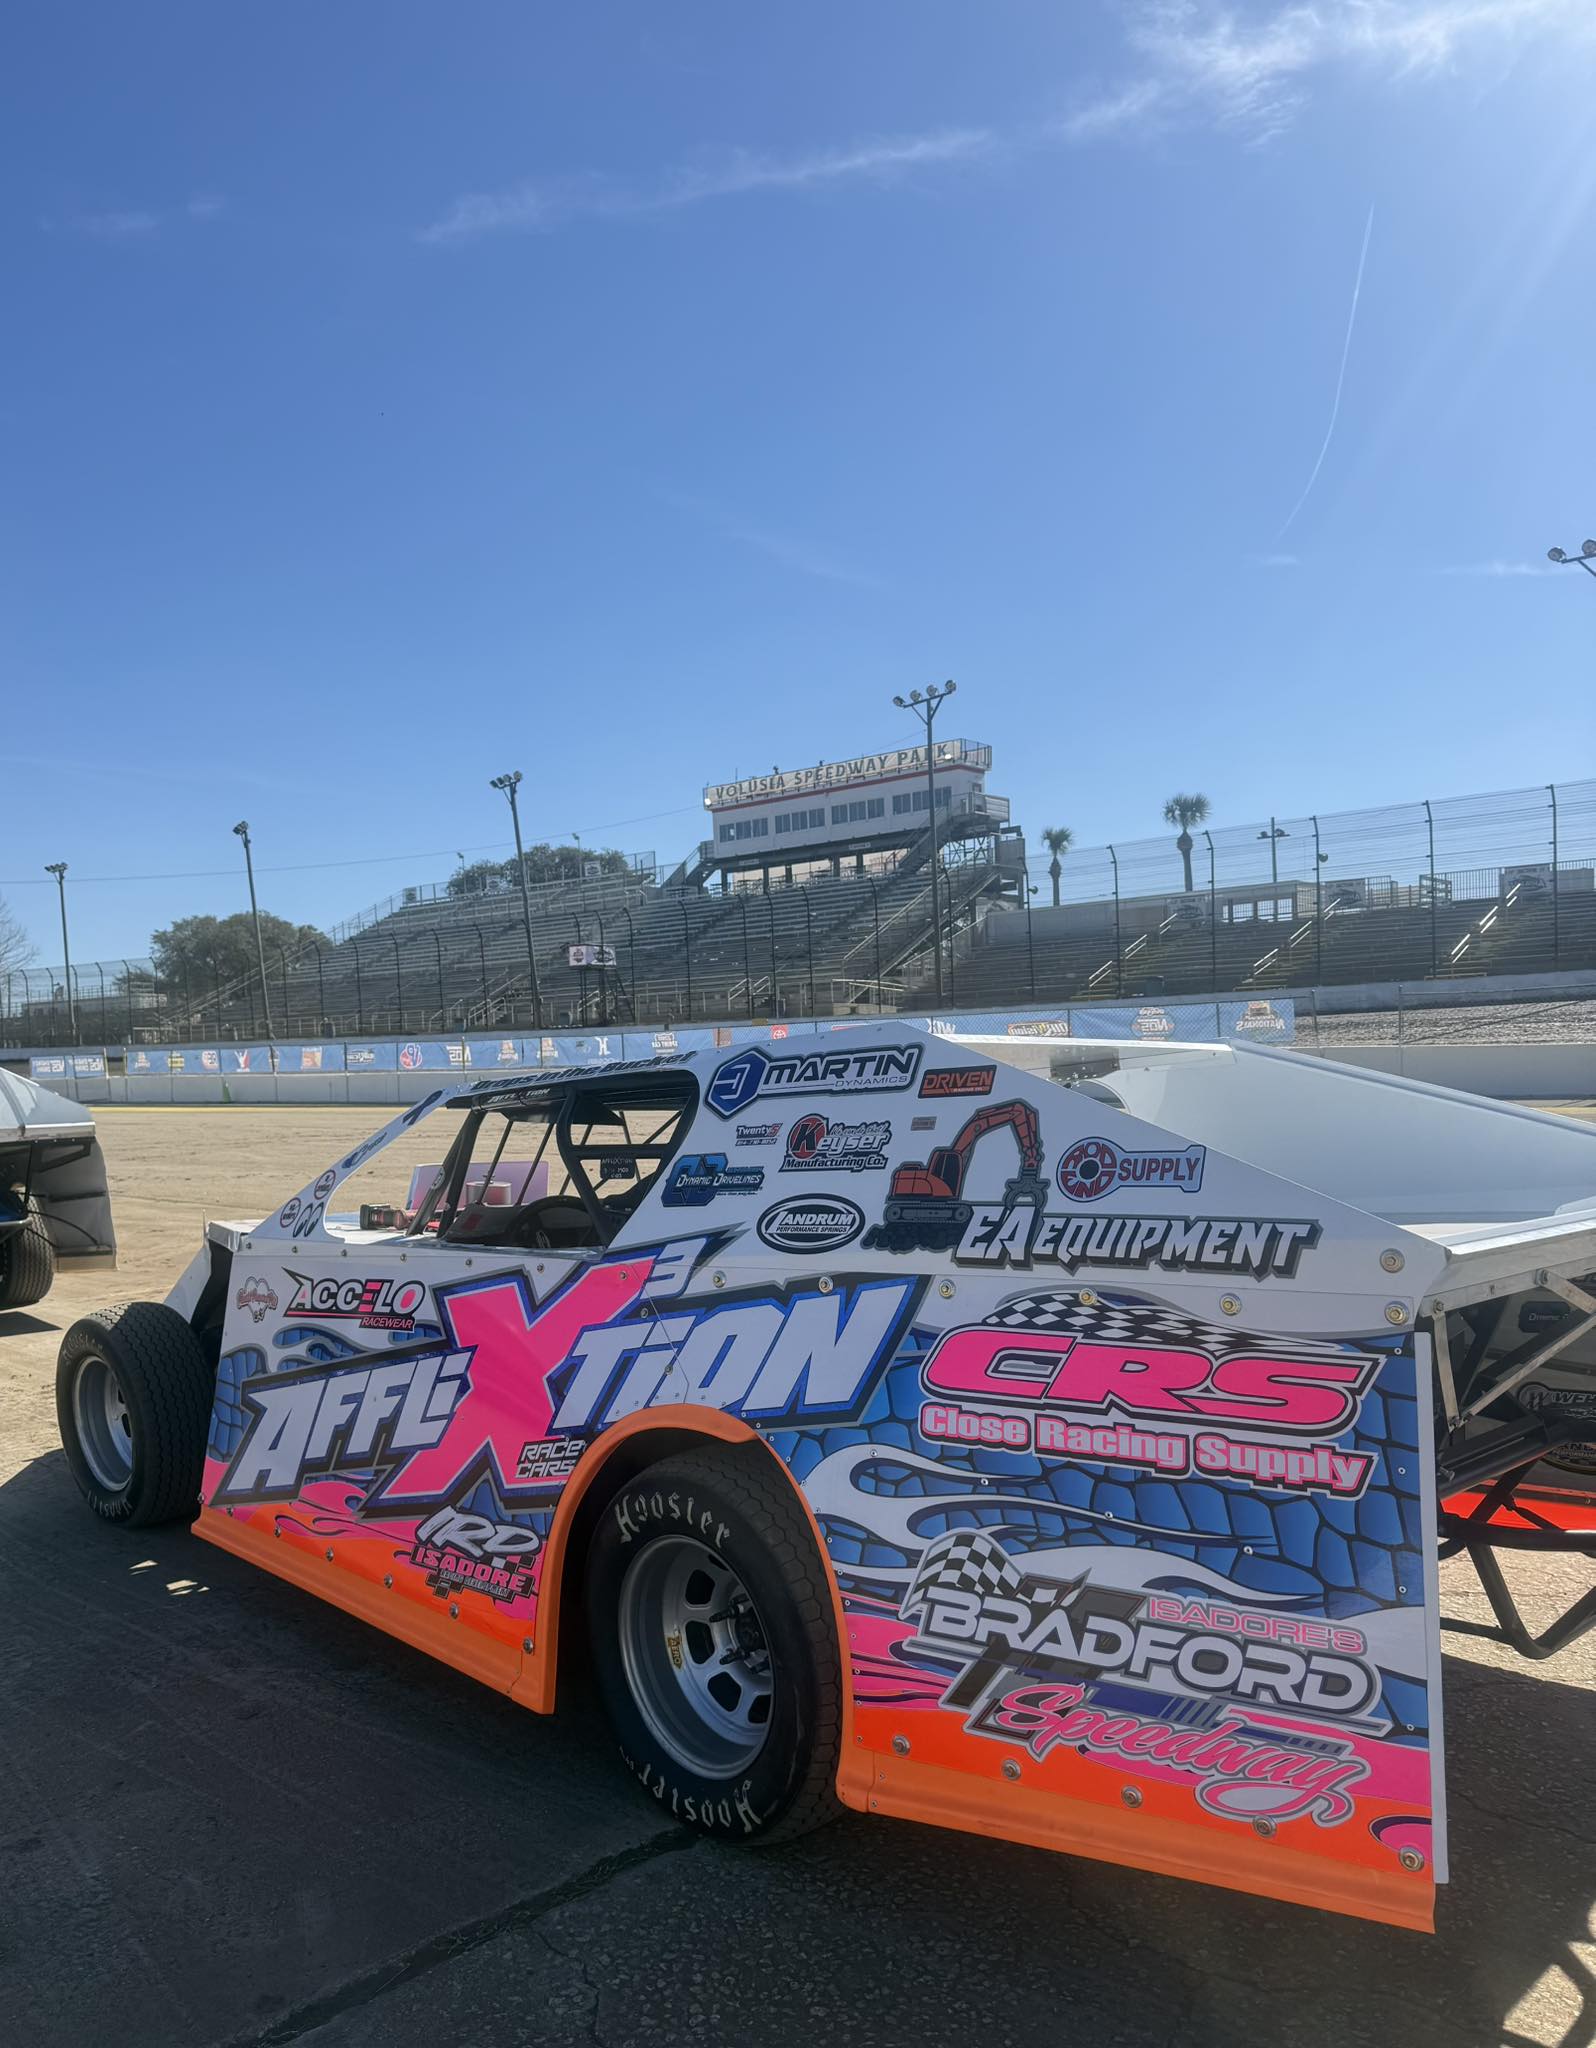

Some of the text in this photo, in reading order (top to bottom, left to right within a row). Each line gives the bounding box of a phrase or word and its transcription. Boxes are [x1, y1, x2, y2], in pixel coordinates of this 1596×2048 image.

[716, 743, 947, 800] VOLUSIA SPEEDWAY PAK
[763, 1049, 919, 1085] MARTIN
[834, 1075, 908, 1088] DYNAMICS
[922, 1070, 993, 1089] DRIVEN
[790, 1122, 889, 1156] Keyser
[785, 1154, 885, 1170] Manufacturing Co.
[1118, 1157, 1200, 1181] SUPPLY
[676, 1173, 762, 1188] DYNAMIC DRIVELINES
[1060, 1170, 1117, 1198] END
[765, 1211, 856, 1234] LANDRUM
[1032, 1215, 1312, 1274] EQUIPMENT
[288, 1276, 424, 1316] ACCELO
[361, 1316, 414, 1330] RACEWEAR
[926, 1329, 1361, 1425] CRS
[521, 1440, 585, 1461] RACE
[922, 1405, 1369, 1492] Close Racing Supply
[515, 1460, 577, 1479] CARS
[415, 1547, 527, 1592] ISADORE
[1147, 1596, 1363, 1653] ISADORE'S
[671, 1637, 682, 1666] AERO
[926, 1585, 1369, 1711] BRADFORD
[995, 1683, 1364, 1820] Speedway
